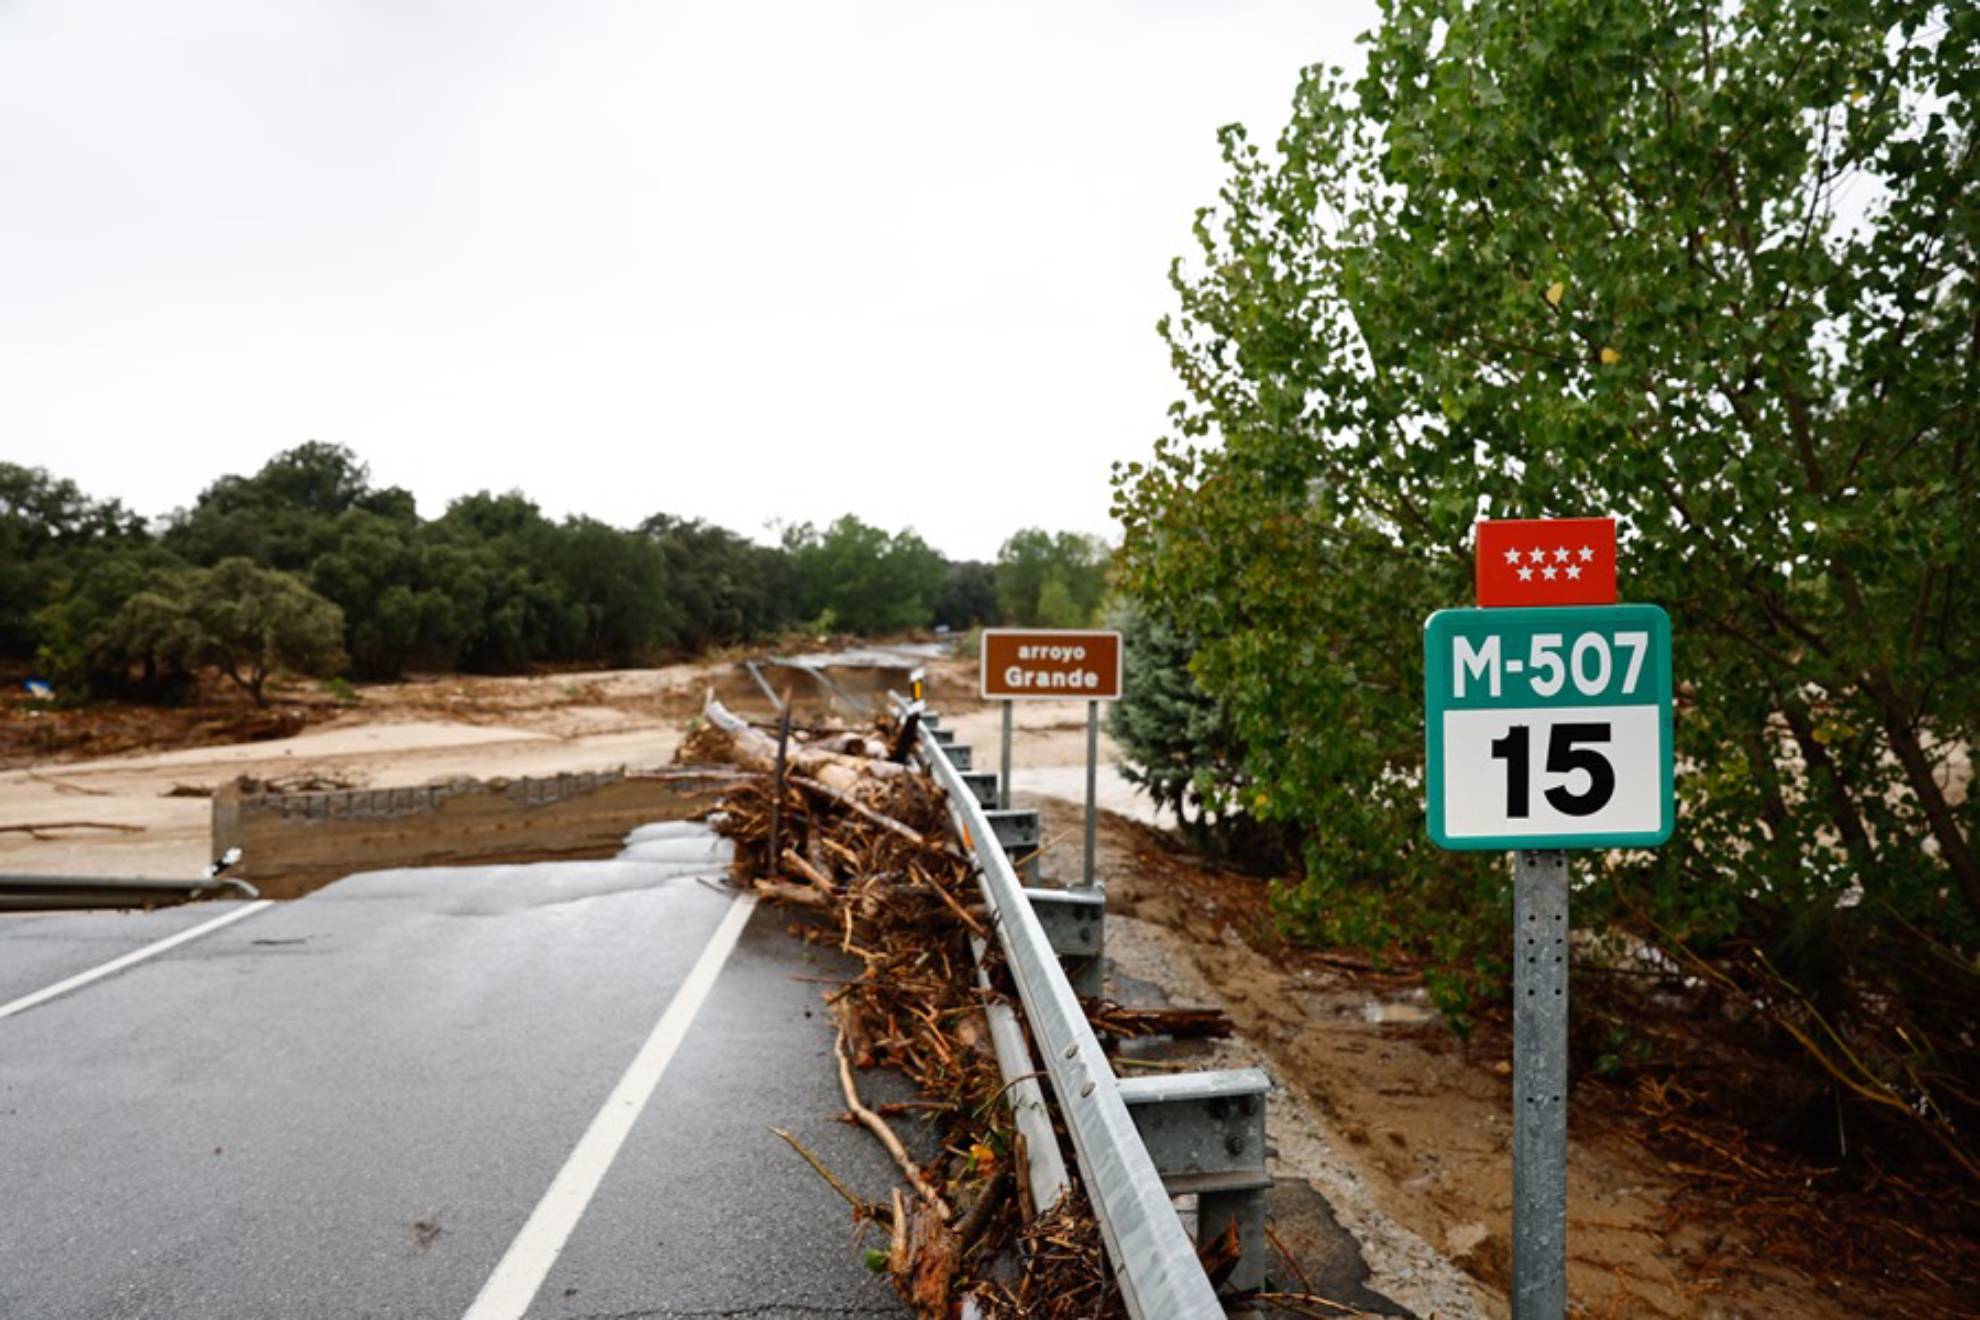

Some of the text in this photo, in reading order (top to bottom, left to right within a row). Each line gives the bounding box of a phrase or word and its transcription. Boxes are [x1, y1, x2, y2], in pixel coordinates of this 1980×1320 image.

[1018, 645, 1086, 663] arroyo
[1453, 631, 1649, 698] M-507
[1005, 666, 1099, 688] Grande
[1491, 723, 1616, 819] 15
